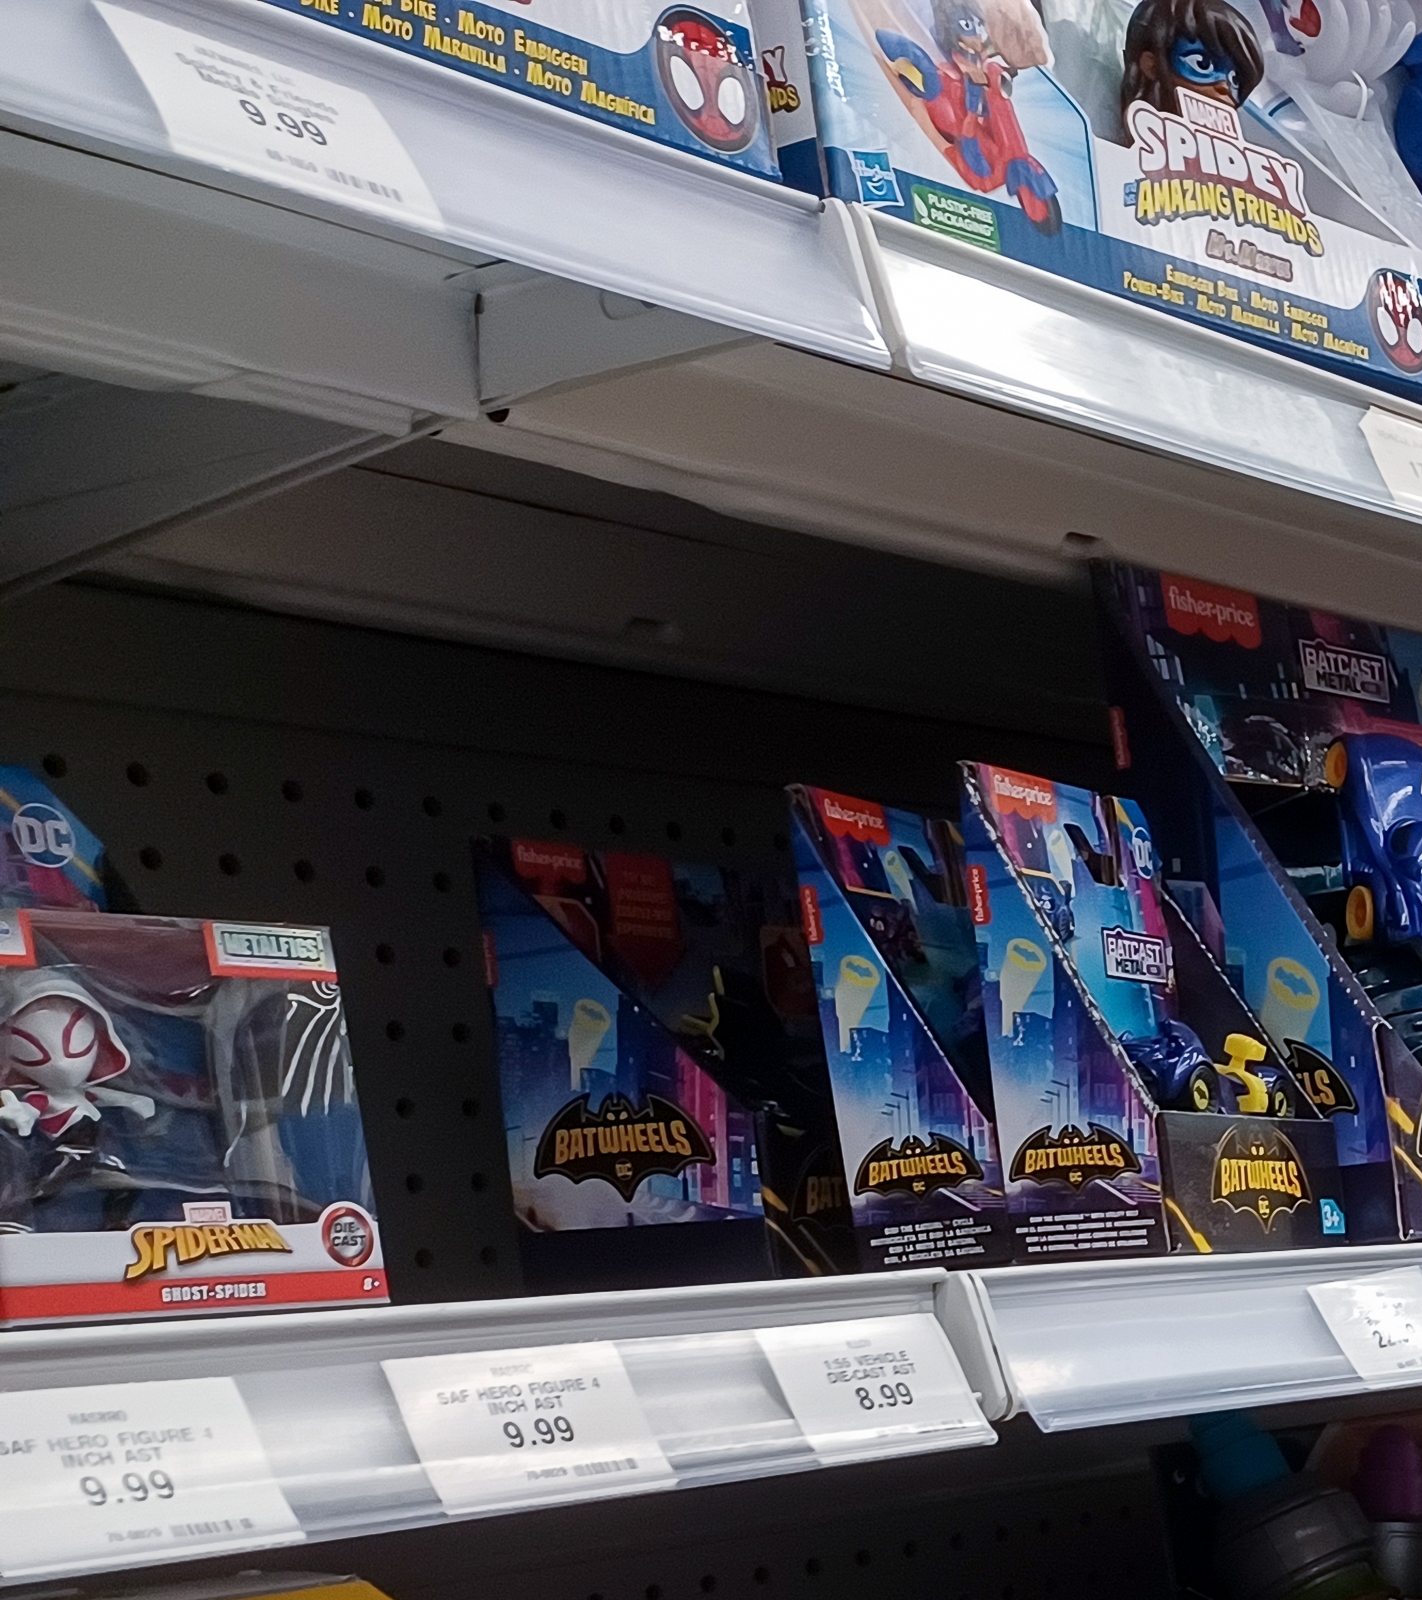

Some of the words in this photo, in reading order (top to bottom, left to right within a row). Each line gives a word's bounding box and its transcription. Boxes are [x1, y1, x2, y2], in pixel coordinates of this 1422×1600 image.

[458, 11, 505, 46] MOTO
[514, 30, 588, 76] EMBIGGEN
[362, 7, 412, 40] MOTO
[424, 25, 506, 73] MARAVILLA
[527, 61, 572, 97] MOTO
[581, 81, 655, 126] MAGNÍFICA
[239, 99, 328, 146] 9.99
[1186, 96, 1237, 139] MARVEL
[1134, 108, 1306, 215] SPIDEY
[928, 193, 993, 224] PLASTIC-FREE
[1138, 178, 1232, 220] AMAZING
[1233, 187, 1324, 256] FRIENDS
[1168, 586, 1255, 627] fisher-price
[1306, 648, 1382, 682] BATCAST
[1316, 673, 1362, 694] METAL
[993, 775, 1054, 806] fisher-price
[824, 799, 884, 830] fisher-price
[16, 816, 72, 853] DC
[1134, 834, 1153, 870] DC
[1108, 937, 1163, 964] BATCAST
[1115, 957, 1146, 976] METAL
[554, 1119, 693, 1166] BATWHEELS
[1024, 1143, 1125, 1173] BATWHEELS
[868, 1151, 968, 1186] BATWHEELS
[1221, 1158, 1302, 1196] BATWHEELS
[1322, 1207, 1342, 1229] 3+
[125, 1223, 292, 1280] SPIDER-MAN
[332, 1234, 366, 1248] CAST
[161, 1282, 267, 1302] GHOST-SPIDER
[826, 1366, 887, 1385] DIE-CAST
[892, 1362, 916, 1377] AST
[855, 1350, 909, 1367] VEHICLE
[437, 1389, 470, 1405] SAF
[477, 1382, 523, 1401] HERO
[529, 1378, 584, 1396] FIGURE
[534, 1394, 563, 1411] AST
[857, 1382, 914, 1411] 8.99
[47, 1432, 109, 1453] HERO
[118, 1427, 193, 1447] FIGURE
[502, 1415, 574, 1448] 9.99
[125, 1447, 163, 1464] AST
[80, 1469, 174, 1506] 9.99
